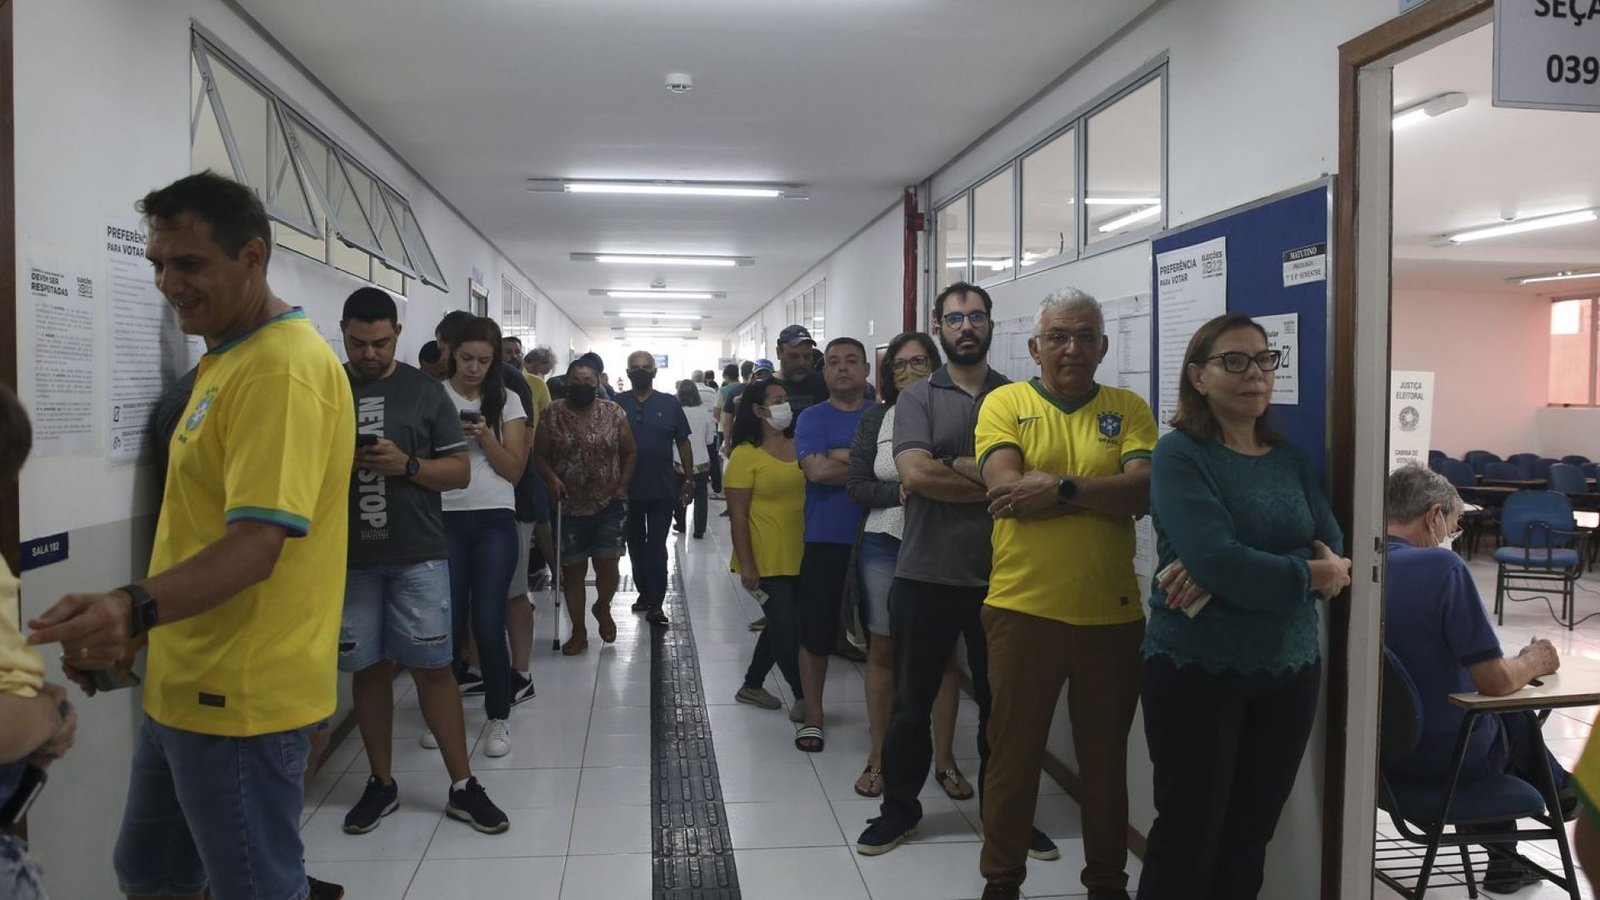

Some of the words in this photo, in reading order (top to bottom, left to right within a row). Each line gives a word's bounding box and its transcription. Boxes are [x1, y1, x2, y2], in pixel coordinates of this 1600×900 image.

[1546, 54, 1600, 85] 039
[107, 242, 121, 253] PARA
[122, 244, 145, 258] VOTAR
[1201, 249, 1223, 262] ELEIÇÕES
[1290, 247, 1317, 260] MATUTINO
[1160, 258, 1197, 275] PREFERÊNCIA
[1160, 277, 1171, 287] PARA
[1171, 273, 1188, 285] VOTAR
[1299, 268, 1321, 279] SEMESTRE
[1400, 381, 1422, 390] JUSTIÇA
[1396, 391, 1424, 400] ELEITORAL
[31, 543, 49, 557] SALA
